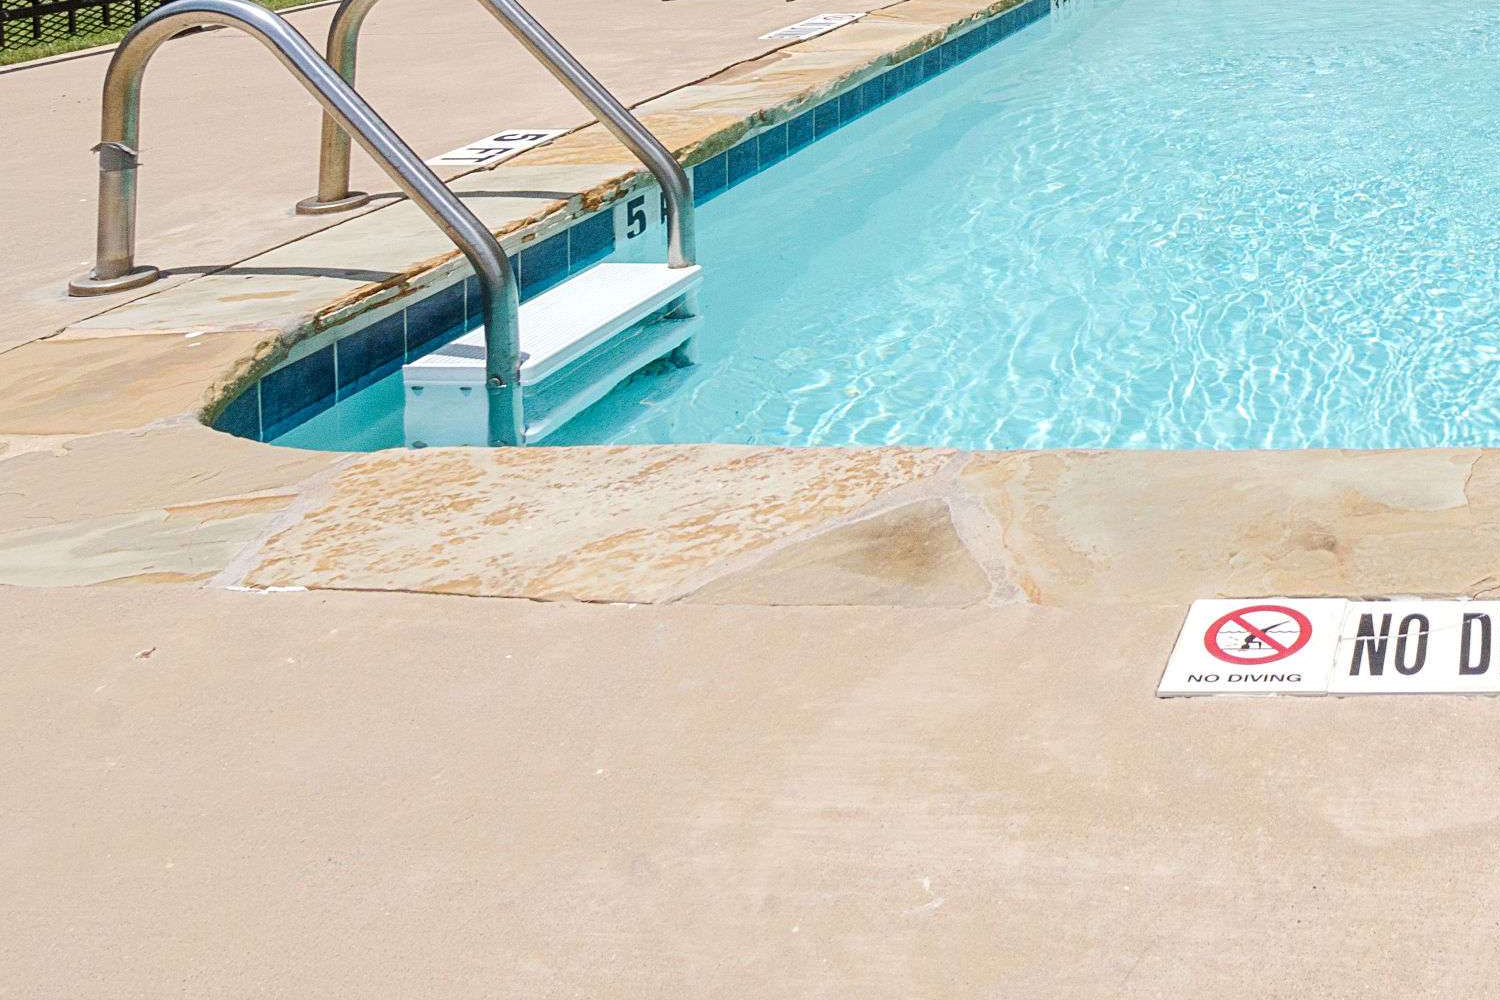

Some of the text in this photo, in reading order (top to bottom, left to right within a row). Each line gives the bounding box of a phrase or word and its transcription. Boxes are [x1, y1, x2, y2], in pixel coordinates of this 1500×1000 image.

[440, 133, 550, 163] 5 FT
[627, 194, 647, 239] 5
[1349, 613, 1430, 676] NO
[1187, 673, 1302, 683] NO DIVING
